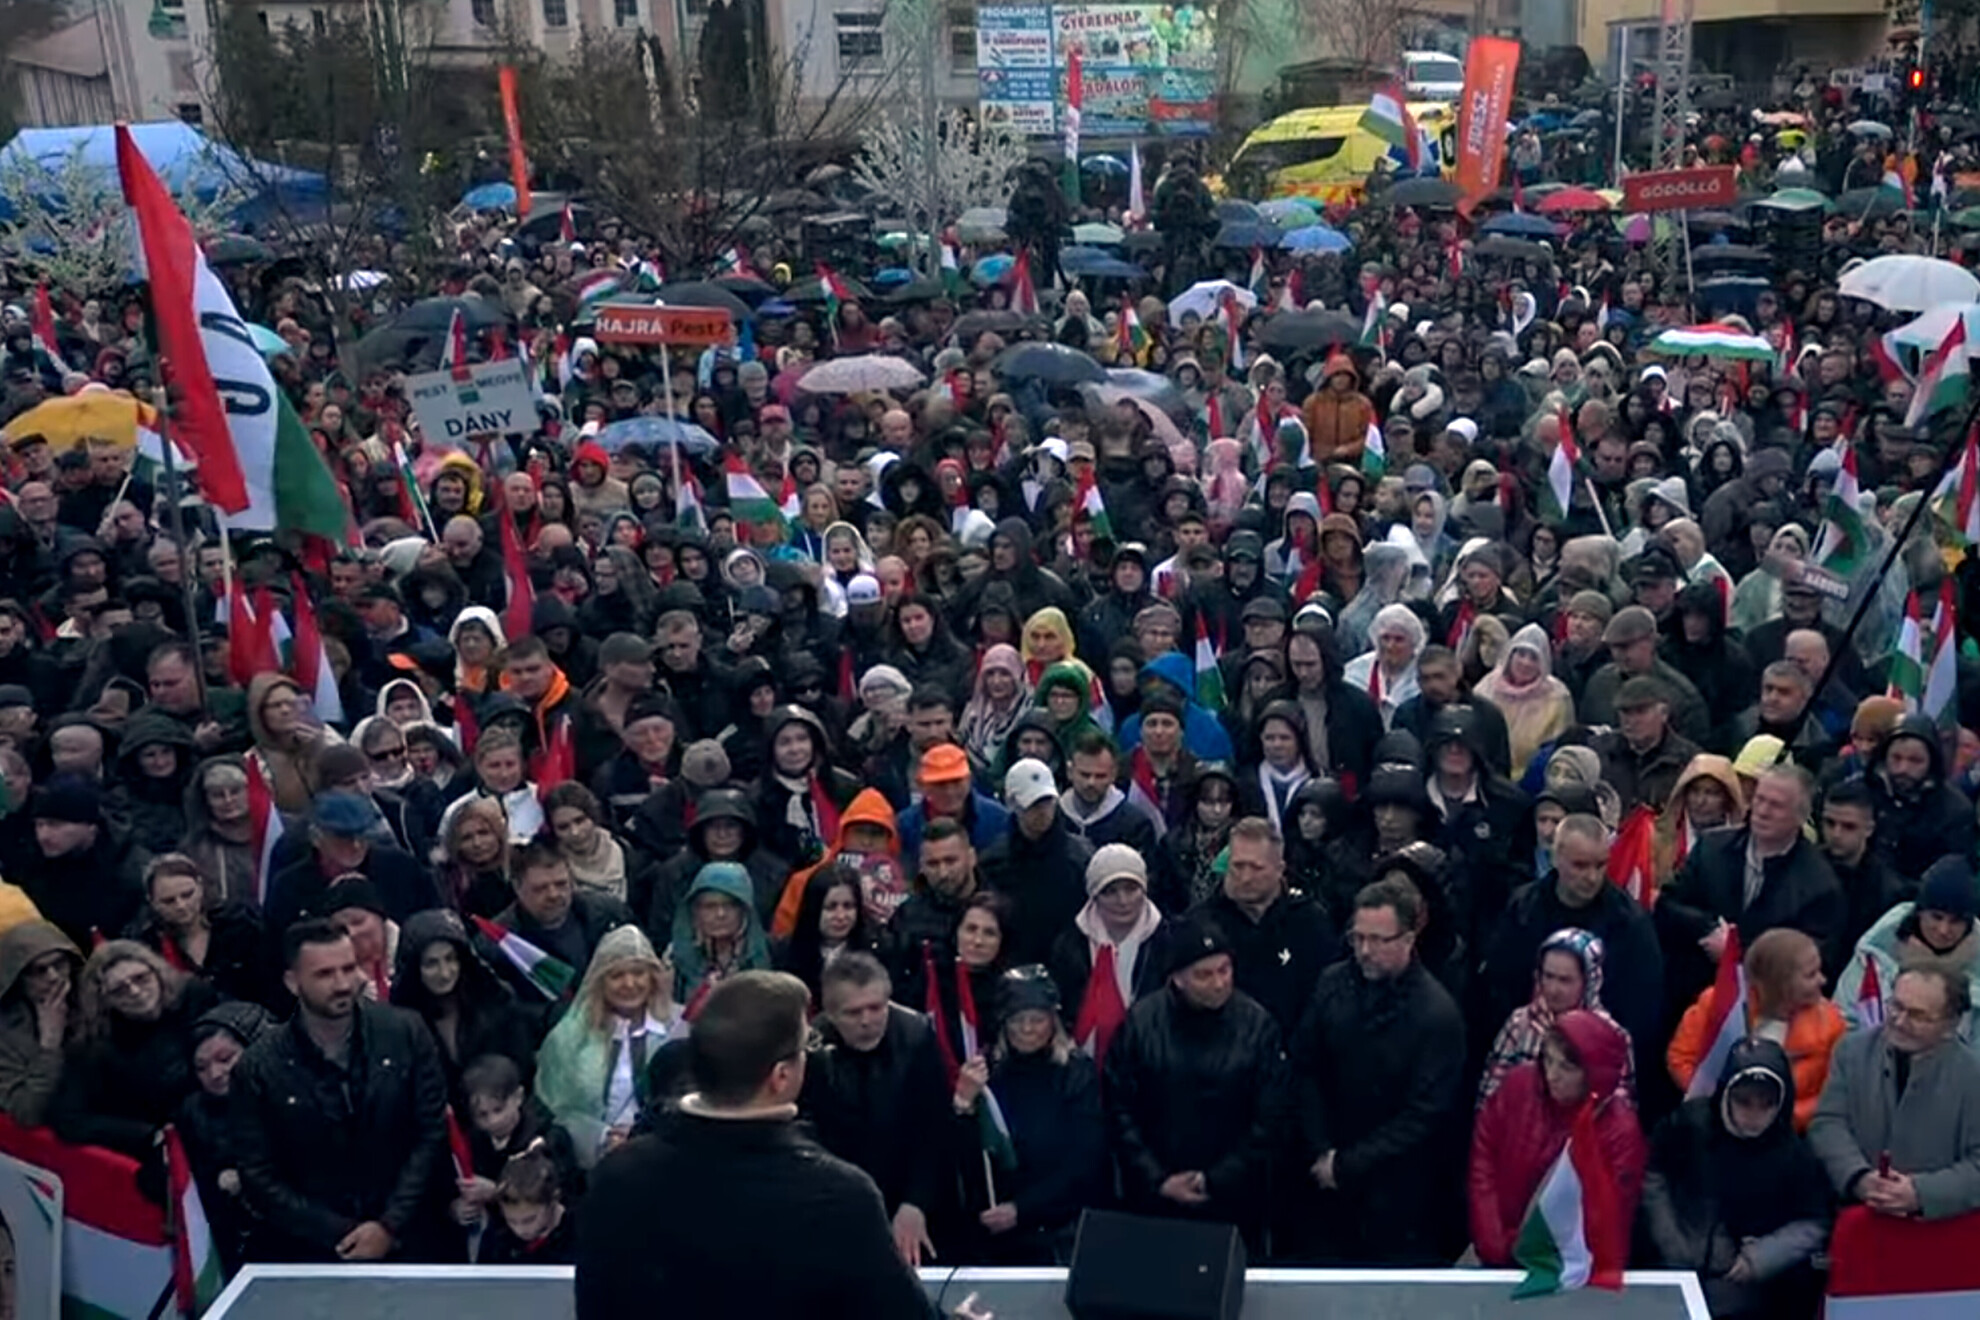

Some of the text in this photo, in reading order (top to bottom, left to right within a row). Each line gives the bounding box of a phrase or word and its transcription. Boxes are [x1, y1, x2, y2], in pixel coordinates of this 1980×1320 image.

[1060, 11, 1142, 31] GYEREKNAP
[1467, 90, 1489, 156] FIDESZ
[596, 316, 664, 336] HAJRÁ
[671, 321, 714, 337] Pest
[413, 371, 522, 400] PEST MEGYE
[445, 406, 514, 437] DÁNY
